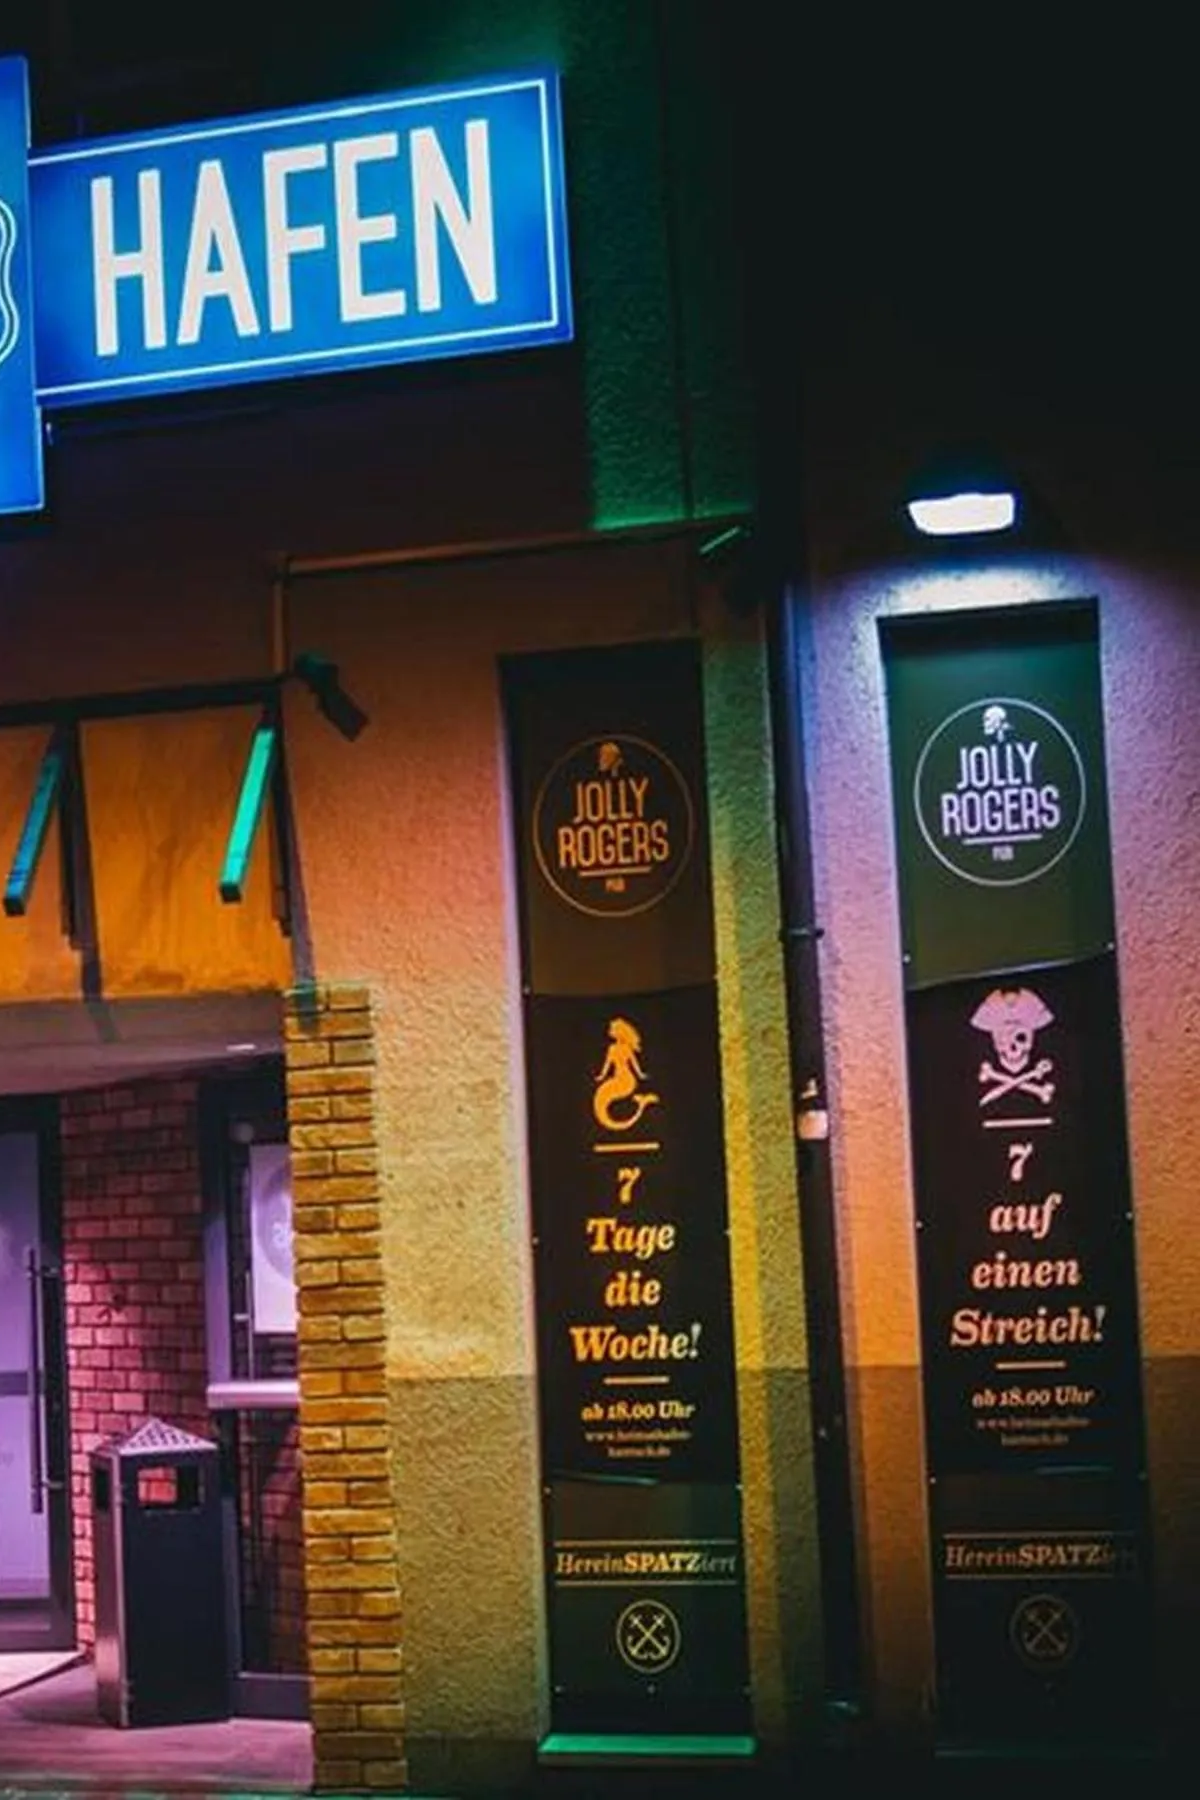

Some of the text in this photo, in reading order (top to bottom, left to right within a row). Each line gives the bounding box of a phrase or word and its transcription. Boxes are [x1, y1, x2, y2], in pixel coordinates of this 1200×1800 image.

[91, 119, 498, 357] HAFEN
[957, 741, 1038, 790] JOLLY
[573, 776, 649, 824] JOLLY
[941, 784, 1061, 836] ROGERS
[558, 818, 669, 868] ROGERS
[1007, 1142, 1033, 1181] 7
[617, 1166, 642, 1204] 7
[988, 1192, 1063, 1240] auf
[586, 1217, 676, 1260] Tage
[605, 1270, 661, 1307] die
[971, 1250, 1082, 1289] einen
[569, 1322, 701, 1362] Woche!
[950, 1306, 1106, 1346] Streich!
[658, 1400, 697, 1419] Uhr
[1054, 1385, 1096, 1405] Uhr
